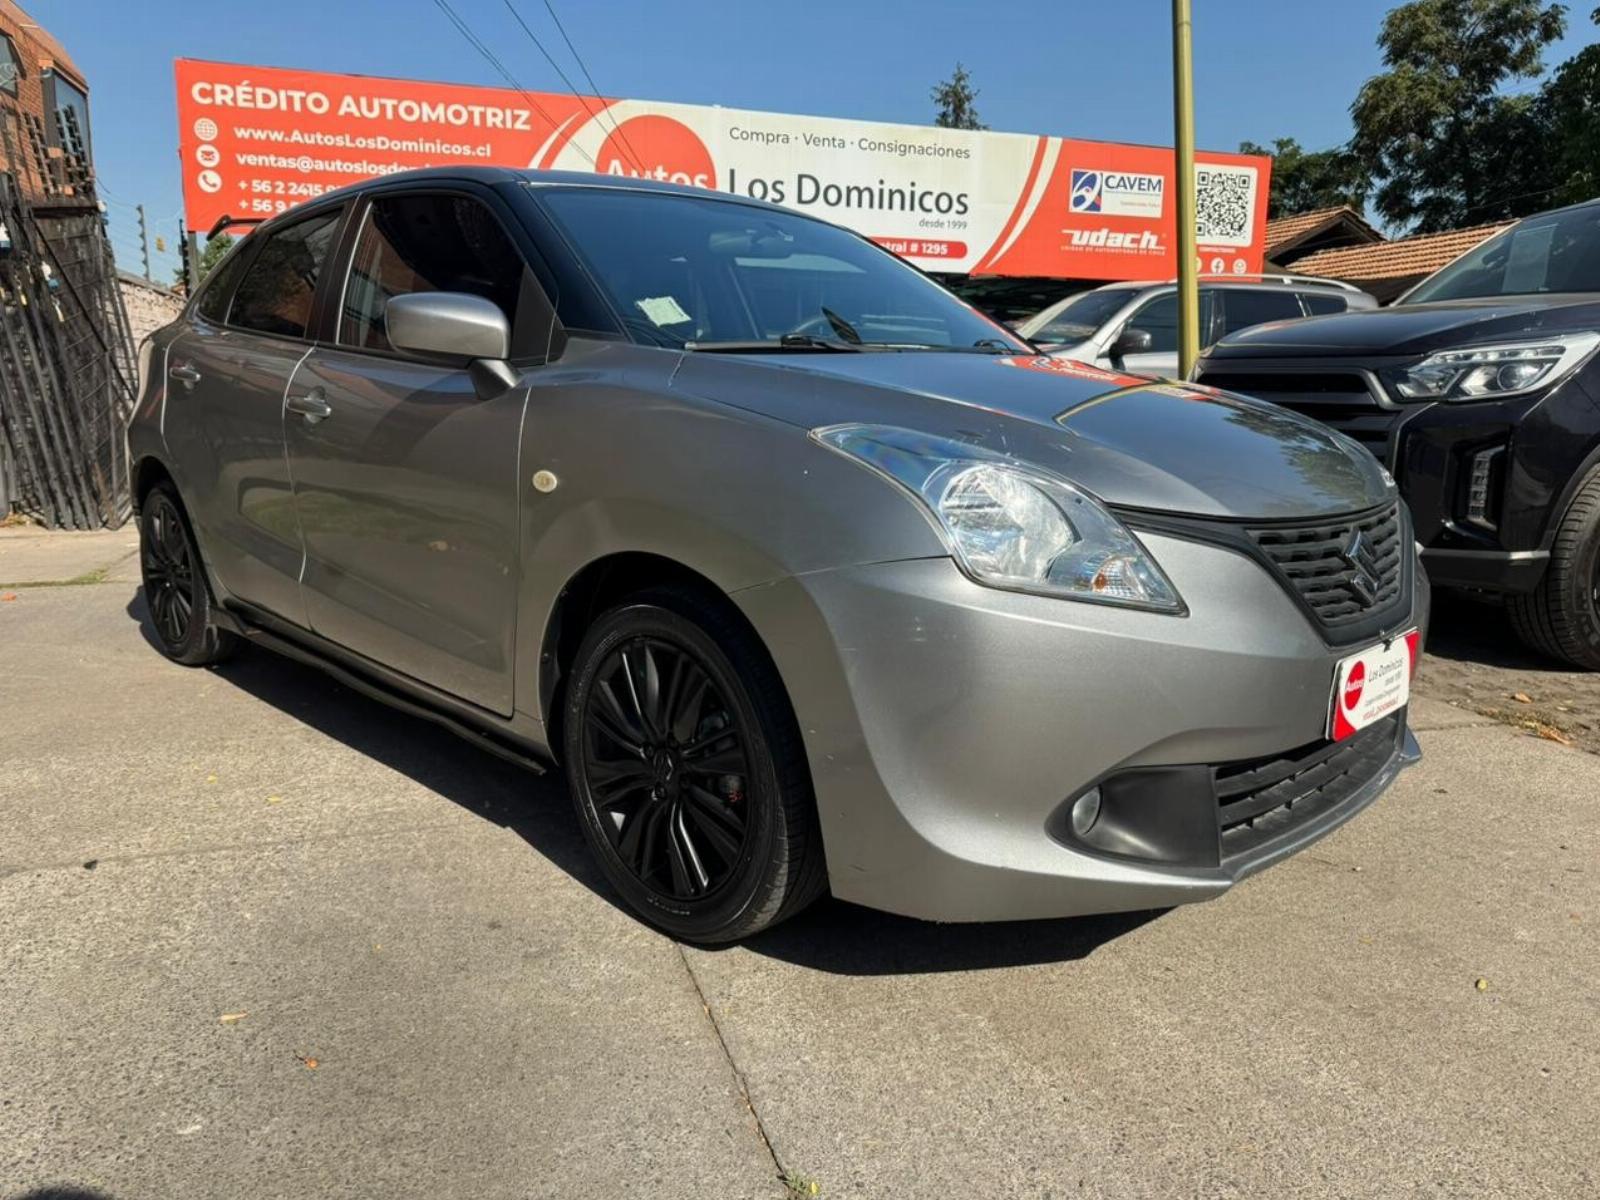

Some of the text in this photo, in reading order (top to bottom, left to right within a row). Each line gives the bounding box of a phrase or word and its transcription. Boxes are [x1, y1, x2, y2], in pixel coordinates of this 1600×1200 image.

[191, 80, 532, 131] CRÉDITO AUTOMOTRIZ
[233, 127, 491, 158] www.AutosLosDominicos.cl
[729, 127, 971, 159] Compra Venta Consignaciones
[251, 179, 272, 194] 56
[274, 181, 285, 195] 2
[796, 173, 969, 215] Dominicos
[1104, 175, 1162, 193] CAVEM
[252, 199, 272, 213] 56
[918, 218, 968, 230] desde 1999
[921, 243, 949, 255] 1295
[1062, 228, 1166, 250] udach
